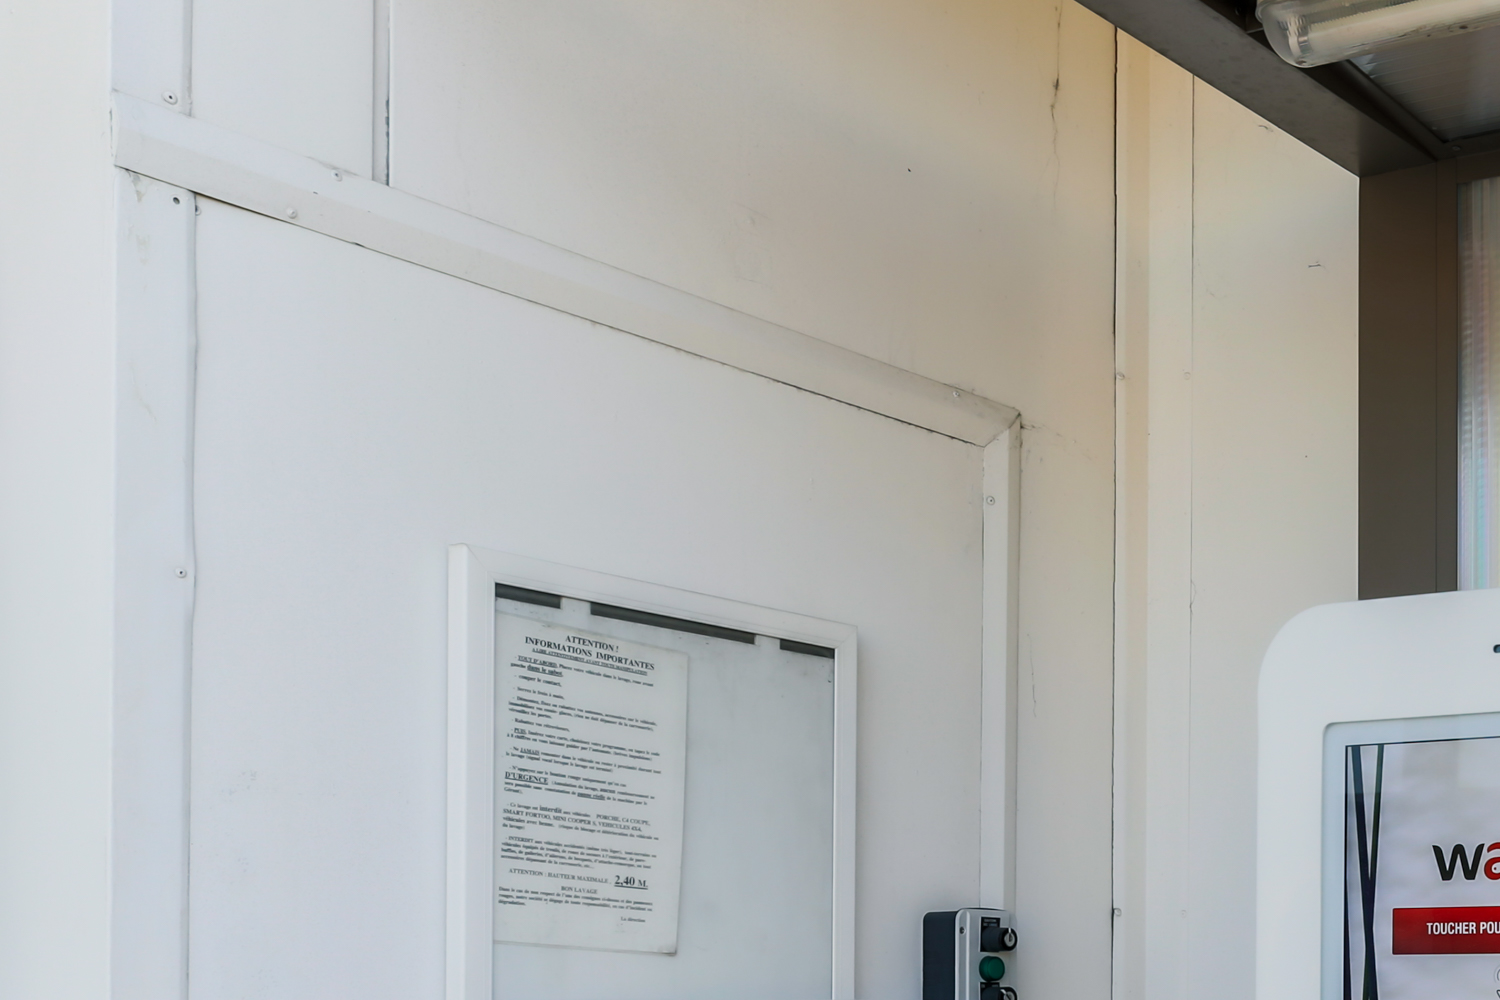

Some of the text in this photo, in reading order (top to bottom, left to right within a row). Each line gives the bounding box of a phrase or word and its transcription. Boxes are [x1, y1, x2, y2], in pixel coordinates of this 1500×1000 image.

[566, 635, 613, 651] ATTENTION
[525, 636, 654, 669] INFORMATIONS IMPORTANTES
[539, 805, 562, 813] interdit
[614, 874, 635, 886] 2,40
[1426, 921, 1477, 935] TOUCHER
